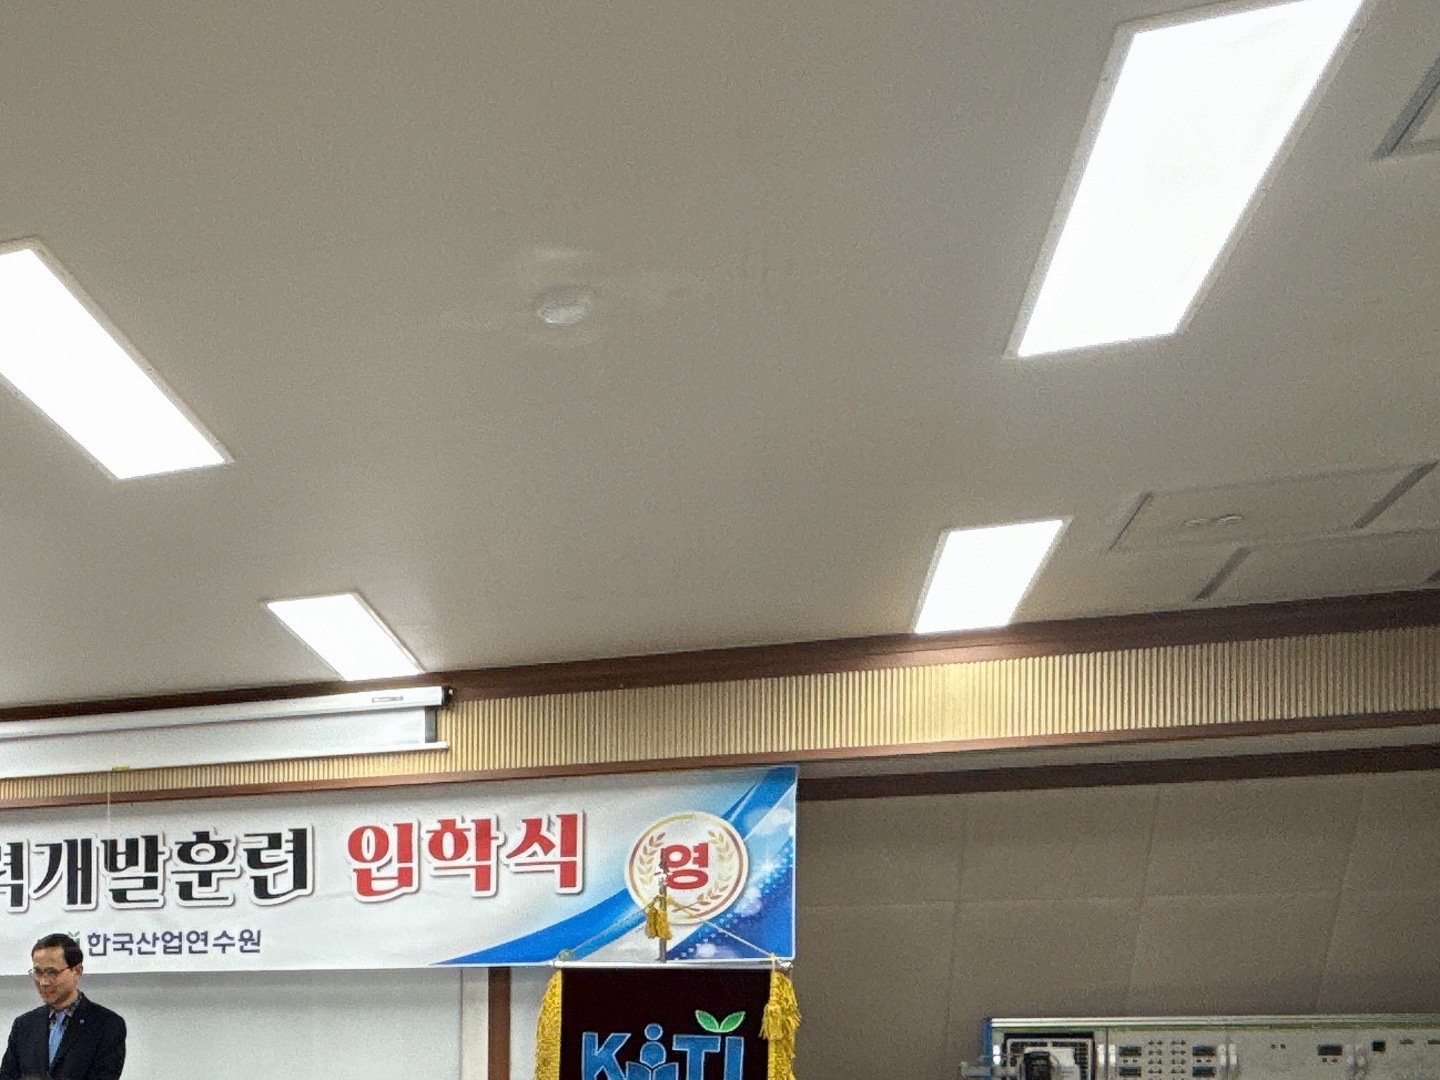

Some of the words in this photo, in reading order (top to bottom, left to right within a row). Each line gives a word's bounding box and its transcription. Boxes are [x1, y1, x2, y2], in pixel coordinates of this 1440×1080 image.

[347, 813, 578, 897] 입학식
[663, 842, 710, 890] 영
[87, 929, 262, 957] 한국산업연수원
